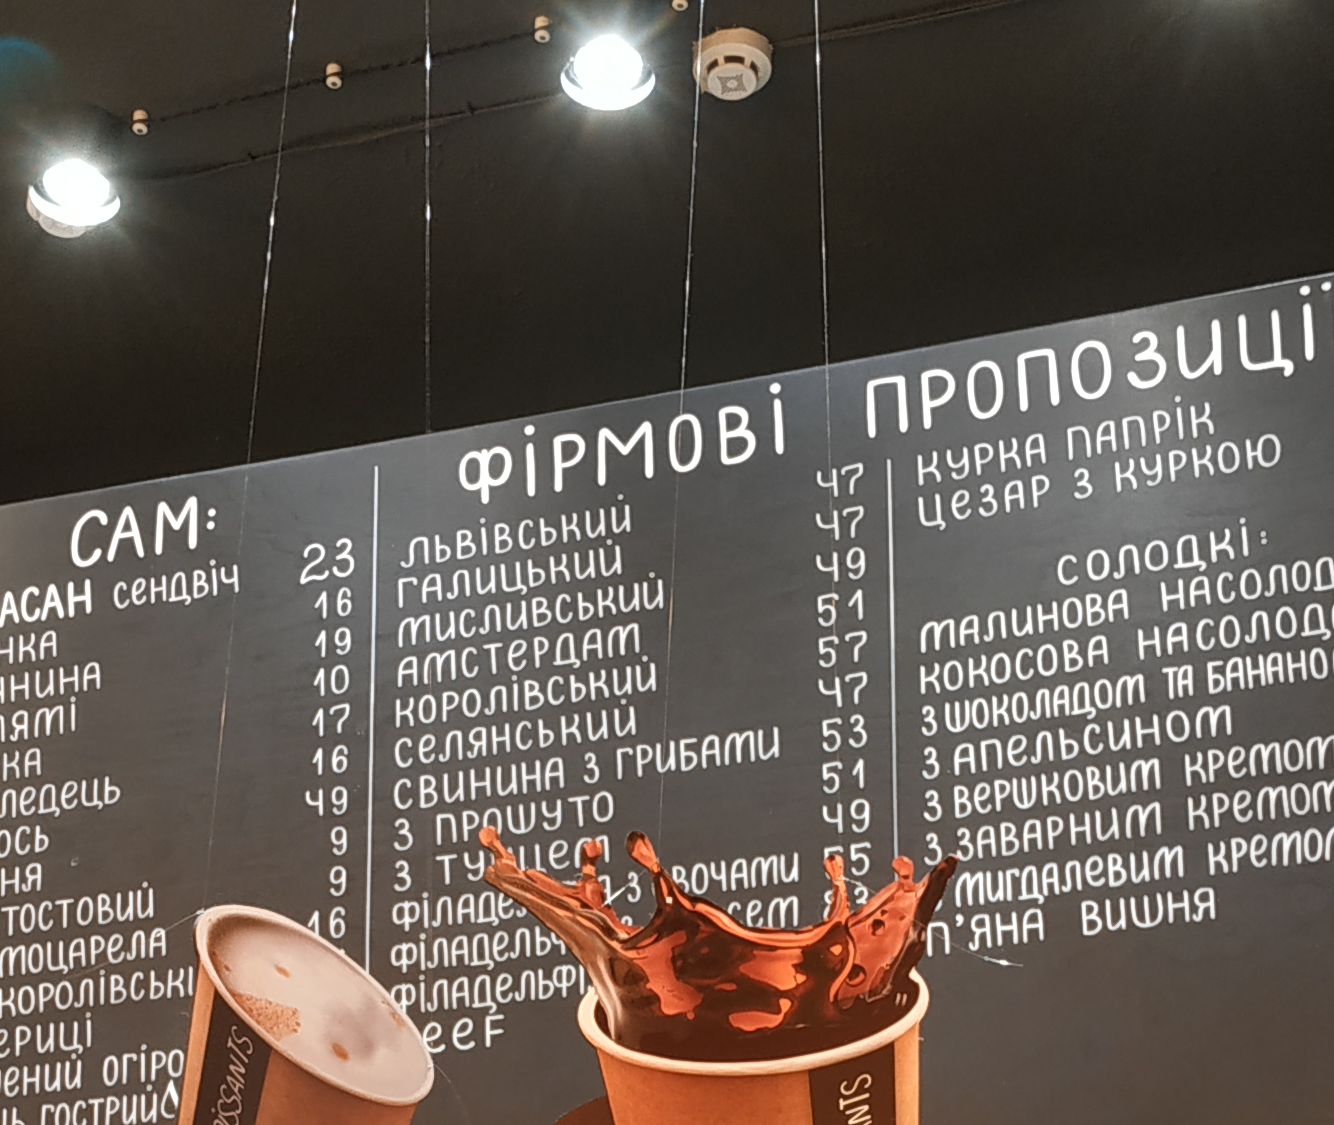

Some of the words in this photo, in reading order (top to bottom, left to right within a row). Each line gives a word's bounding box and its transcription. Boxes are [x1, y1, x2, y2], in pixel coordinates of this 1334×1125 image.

[459, 383, 784, 504] ФІРМОВІ
[918, 434, 1046, 485] КУРКА
[1067, 396, 1214, 460] ПАПРІК
[400, 494, 630, 568] ЛЬВІВСЬКИЙ
[817, 463, 863, 497] 47
[918, 475, 1049, 530] ЦЕЗАР
[1115, 434, 1281, 492] КУРКОЮ
[114, 560, 239, 609] СЕНДВІЧ
[300, 538, 354, 584] 23
[398, 539, 621, 608] ГАЛИЦЬКИЙ
[398, 623, 639, 687] АМСТЕРДАМ
[818, 589, 863, 626] 51
[399, 572, 663, 647] МИСЛИВСЬКИЙ
[921, 589, 1128, 653] МАЛИНОВА
[396, 656, 656, 727] КОРОЛІВСЬКИЙ
[920, 635, 1108, 694] КОКОСОВА
[945, 674, 1145, 732] ШОКОЛАДОМ
[1162, 665, 1193, 699] ТА
[395, 699, 636, 767] СЕЛЯНСЬКИЙ
[819, 672, 867, 707] 47
[954, 705, 1231, 775] АПЕЛЬСИНОМ
[394, 757, 564, 809] СВИНИНА
[617, 727, 779, 779] ГРИБАМИ
[954, 758, 1160, 818] ВЕРШКОВИМ
[955, 802, 1161, 861] ЗАВАРНИМ
[1, 882, 153, 936] ТОСТОВИЙ
[955, 846, 1183, 907] МИГДАЛЕВИМ
[1081, 888, 1215, 935] ВИШНЯ
[0, 928, 166, 978] МОЦАРЕЛА
[391, 965, 589, 1013] ФІЛАДЕЛЬФІ
